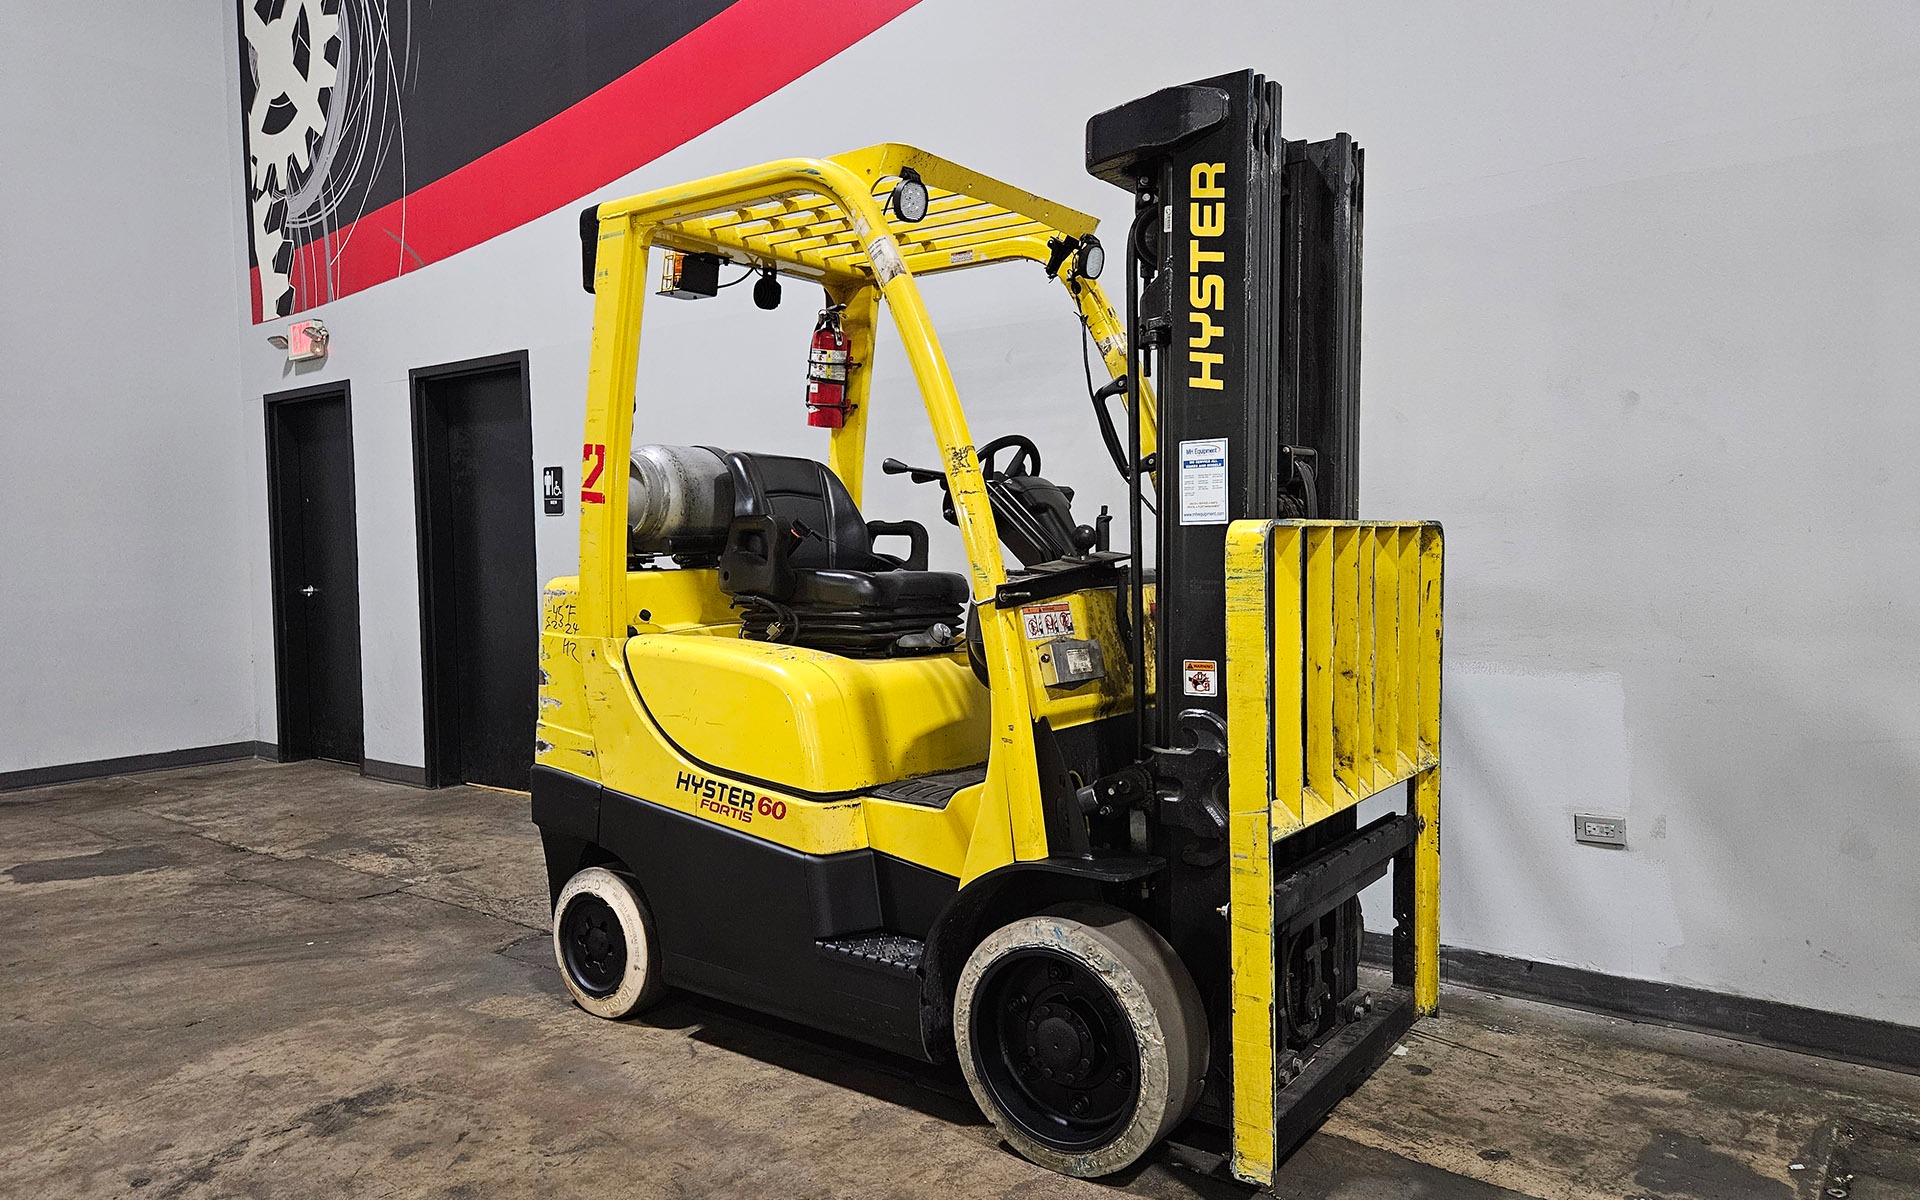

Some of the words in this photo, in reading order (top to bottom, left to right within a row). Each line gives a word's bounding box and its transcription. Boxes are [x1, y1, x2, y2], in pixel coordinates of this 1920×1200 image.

[1189, 162, 1225, 390] HYSTER
[581, 443, 605, 504] 2
[1194, 447, 1217, 455] Equipment
[676, 771, 755, 811] HYSTER
[758, 797, 787, 820] 60
[700, 799, 753, 823] FORTIS
